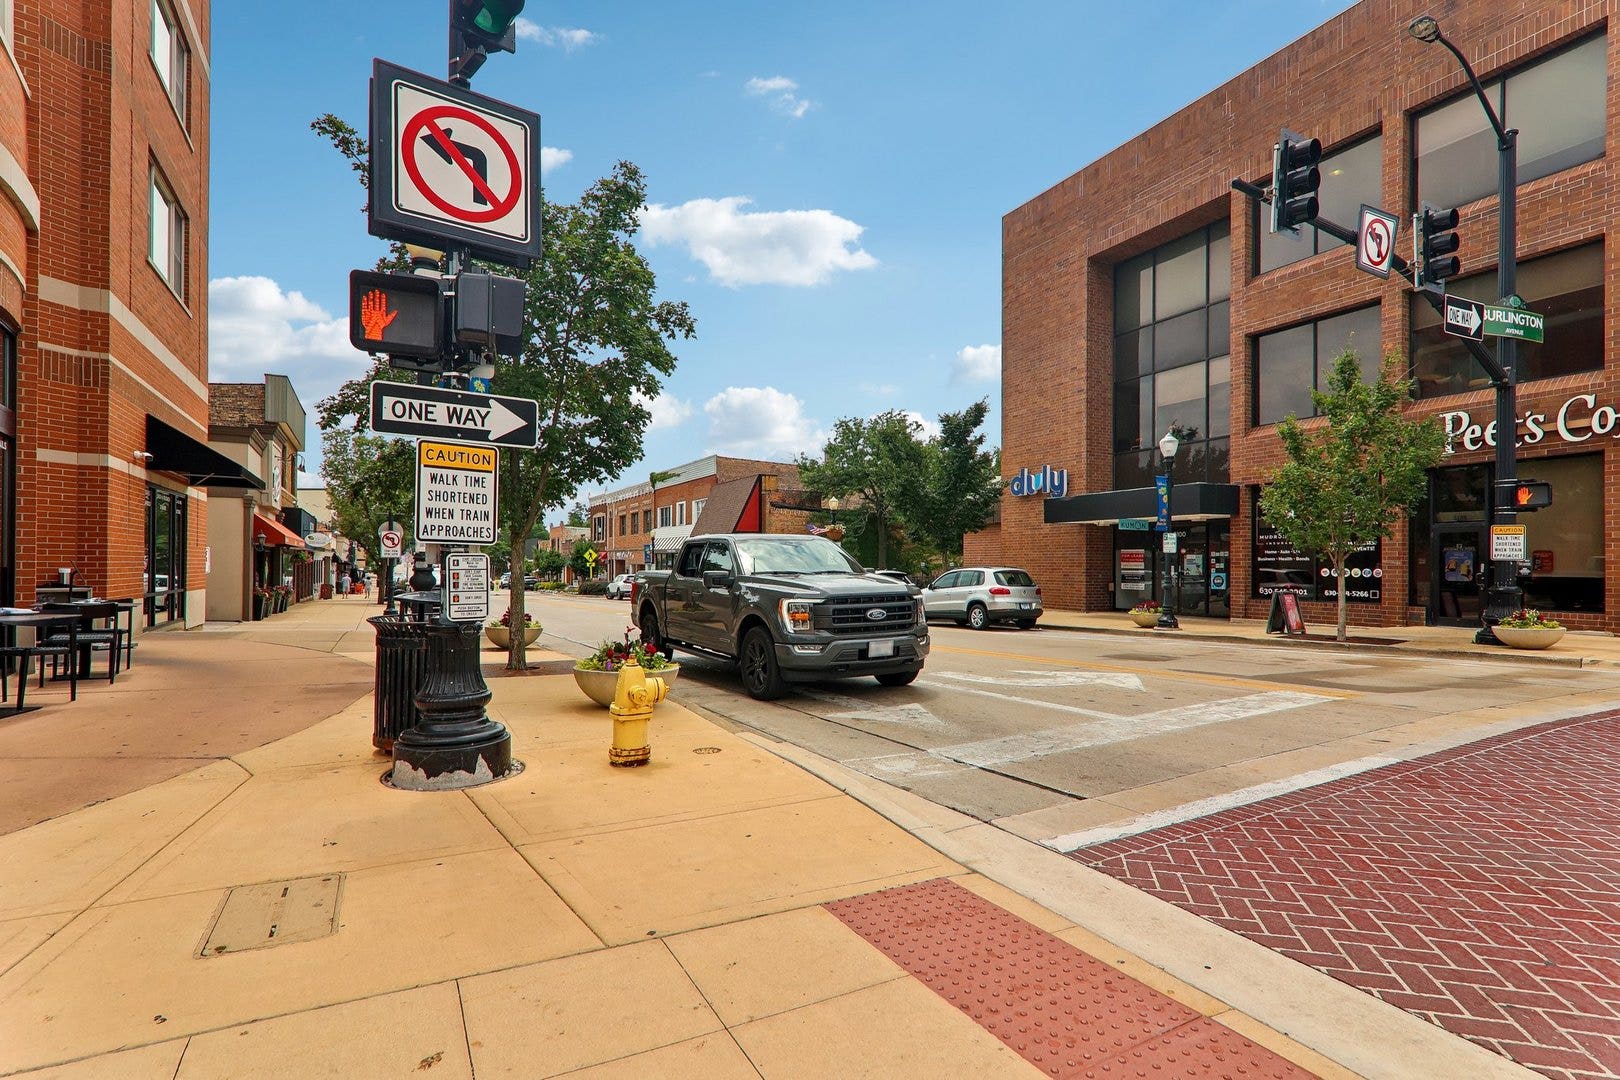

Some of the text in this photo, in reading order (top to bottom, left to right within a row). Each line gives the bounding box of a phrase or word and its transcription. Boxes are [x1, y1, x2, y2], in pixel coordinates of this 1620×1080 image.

[1449, 308, 1473, 326] ONE WAY
[1484, 309, 1543, 329] BURLINGTON
[1505, 327, 1524, 336] AVENUE
[391, 400, 490, 427] ONE WAY
[1557, 394, 1620, 441] Co
[425, 448, 491, 466] CAUTION
[430, 472, 486, 488] WALK TIME
[1010, 464, 1067, 499] duly
[427, 489, 488, 505] SHORTENED
[425, 507, 490, 522] WHEN TRAIN
[422, 524, 492, 539] APPROACHES
[1120, 519, 1147, 529] KUMON
